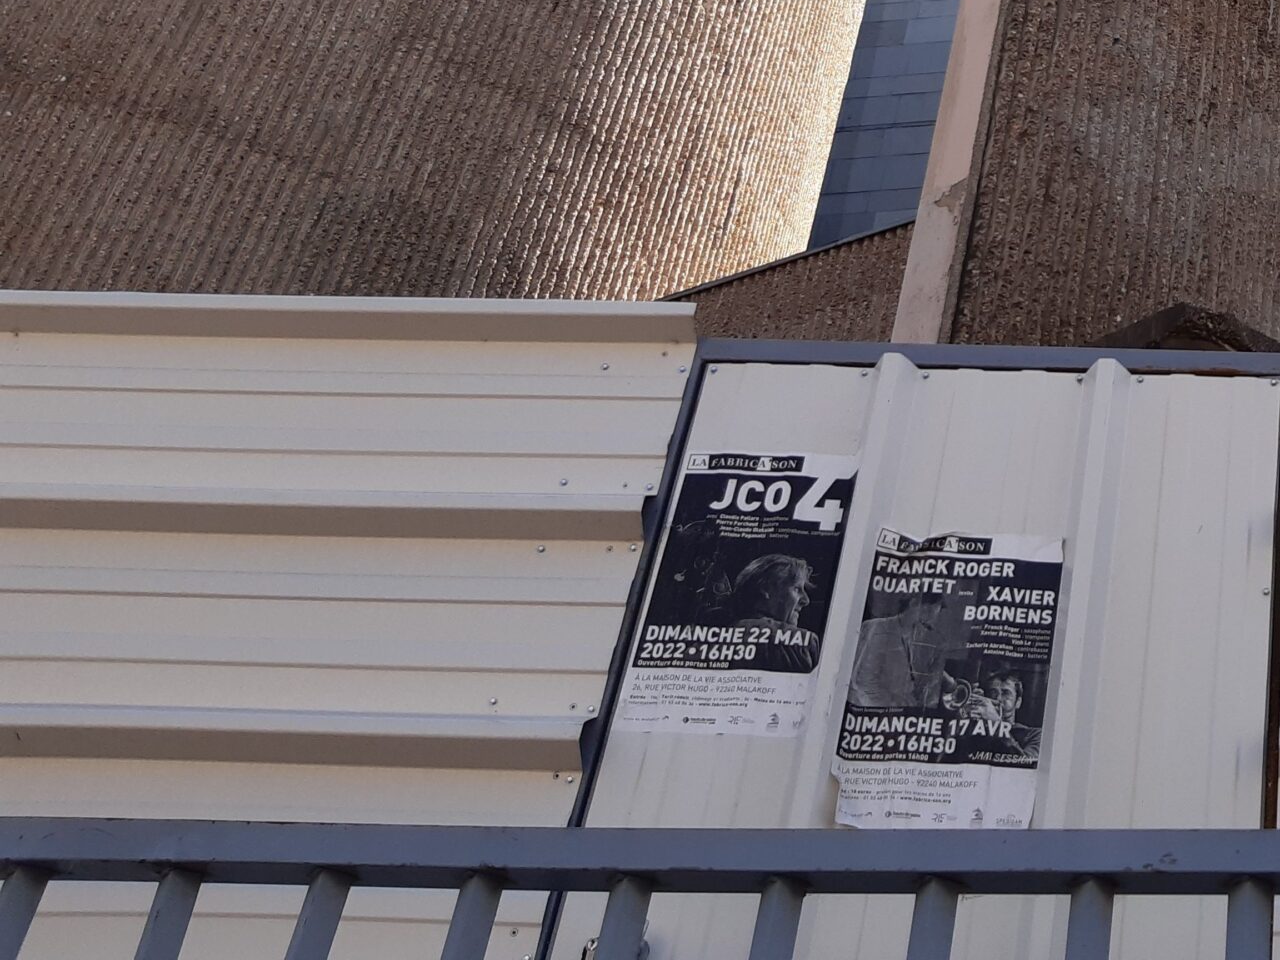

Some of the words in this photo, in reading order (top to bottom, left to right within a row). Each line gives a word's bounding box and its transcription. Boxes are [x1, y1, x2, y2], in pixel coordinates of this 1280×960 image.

[692, 457, 707, 467] LA
[876, 556, 950, 575] FRANCK
[953, 561, 1016, 578] ROGER
[872, 575, 956, 594] QUARTET
[986, 586, 1056, 606] XAVIER
[963, 605, 1053, 625] BORNENS
[646, 625, 745, 643] DIMANCHE
[747, 628, 771, 643] 22
[774, 630, 812, 646] MAI
[653, 674, 680, 682] MAISON
[693, 675, 704, 683] LA
[717, 676, 762, 684] ASSOCIATIVE
[644, 683, 659, 691] RUE
[736, 686, 776, 694] MALAKOFF
[844, 713, 944, 735] DIMANCHE
[948, 719, 969, 736] 17
[972, 719, 1012, 739] AVR
[884, 753, 907, 761] portes
[908, 753, 929, 761] 16h00
[993, 753, 1034, 765] SESSION
[905, 768, 916, 776] VIE
[918, 770, 963, 778] ASSOCIATIVE
[844, 777, 861, 785] RUE
[861, 777, 886, 785] VICTOR
[939, 780, 978, 789] MALAKOFF
